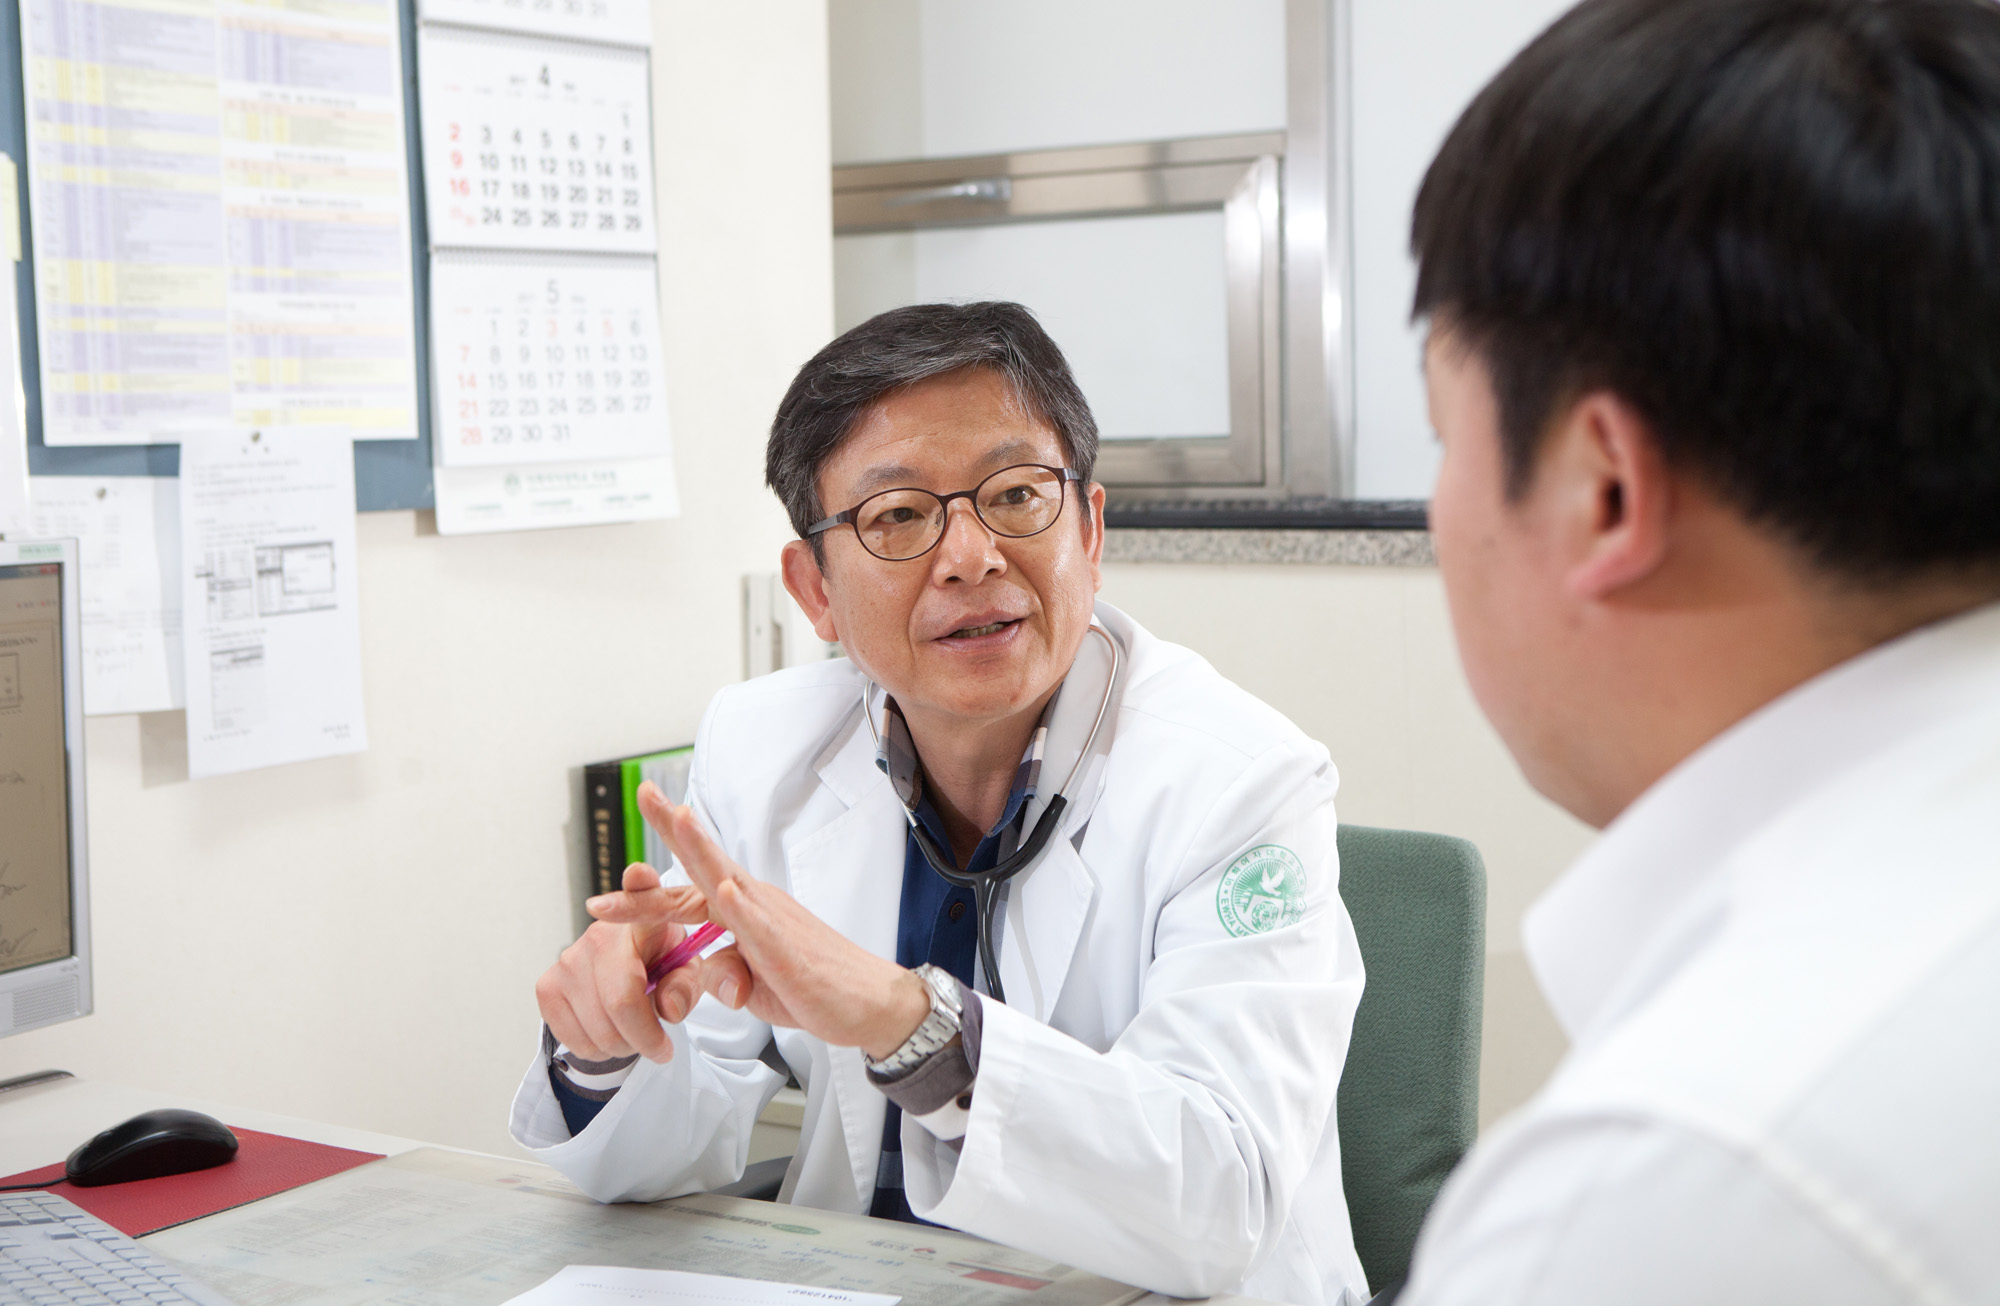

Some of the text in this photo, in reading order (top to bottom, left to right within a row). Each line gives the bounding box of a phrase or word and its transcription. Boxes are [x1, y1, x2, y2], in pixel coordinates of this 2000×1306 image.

[538, 64, 551, 87] 4
[621, 111, 631, 129] 1
[449, 122, 633, 154] 2 3 4 5 6 7 8
[450, 150, 639, 181] 9 10 11 12 13 14 15
[449, 178, 640, 207] 16 17 18 19 20 21 22
[482, 206, 503, 225] 24
[512, 207, 532, 227] 25
[541, 209, 561, 227] 26
[569, 210, 589, 229] 27
[598, 213, 617, 231] 28
[624, 214, 643, 232] 29
[546, 277, 561, 306] 5
[490, 317, 641, 339] 1 2 3 4 5 6
[459, 343, 649, 366] 7 8 9 10 11 12 13
[457, 369, 651, 392] 14 15 16 17 18 19 20
[459, 393, 652, 420] 21 22 23 24 25 26 27
[460, 422, 571, 446] 28 29 30 31
[1221, 898, 1236, 928] EWHA
